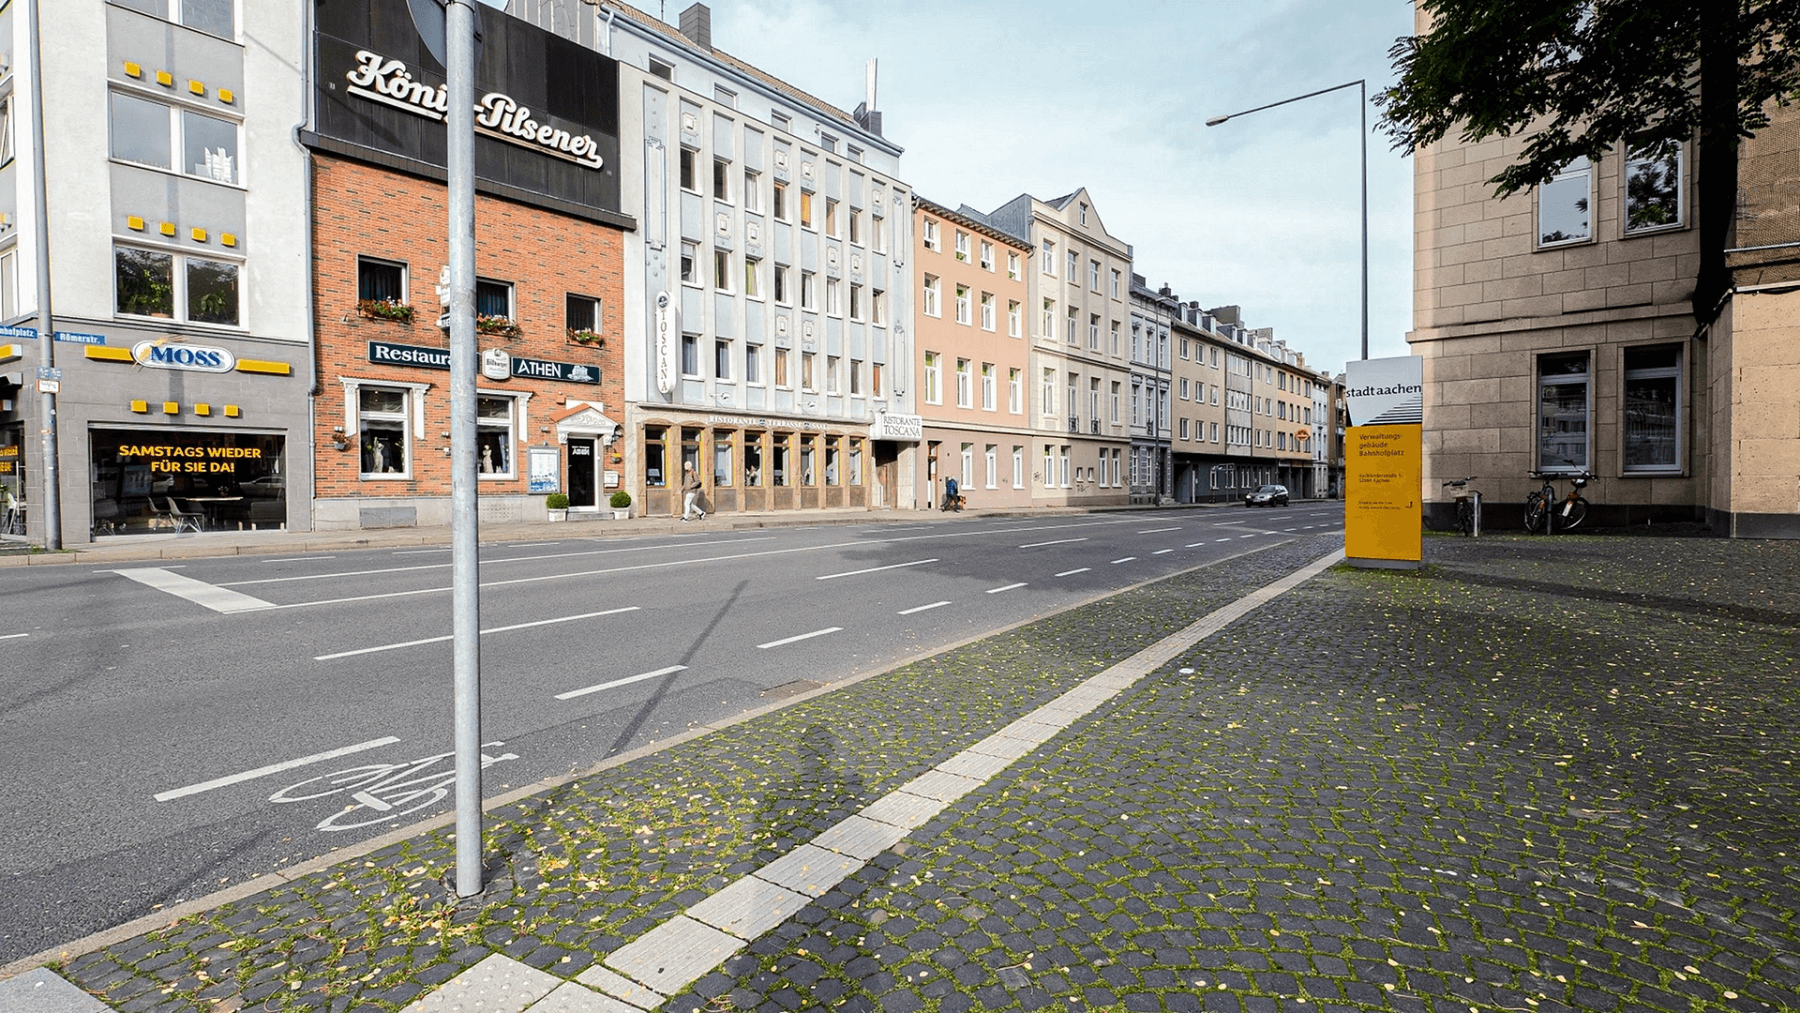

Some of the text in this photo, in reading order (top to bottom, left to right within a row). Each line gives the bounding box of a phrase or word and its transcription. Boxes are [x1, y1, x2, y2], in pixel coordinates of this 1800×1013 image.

[346, 50, 604, 169] Köni-Pilsener
[60, 333, 100, 344] Römerstr.
[150, 346, 222, 367] MOSS
[375, 345, 451, 365] Restaur
[660, 310, 668, 391] TOSCANA
[517, 359, 561, 378] ATHEN
[1346, 384, 1422, 397] stadt aachen
[709, 416, 756, 425] RISTORANTE
[883, 416, 921, 426] RISTORANTE
[884, 425, 921, 437] TOSCANA
[119, 444, 262, 459] SAMSTAGS WIEDER
[1359, 449, 1404, 457] Bahnhofplatz
[151, 461, 235, 473] FÜR SIE DA!
